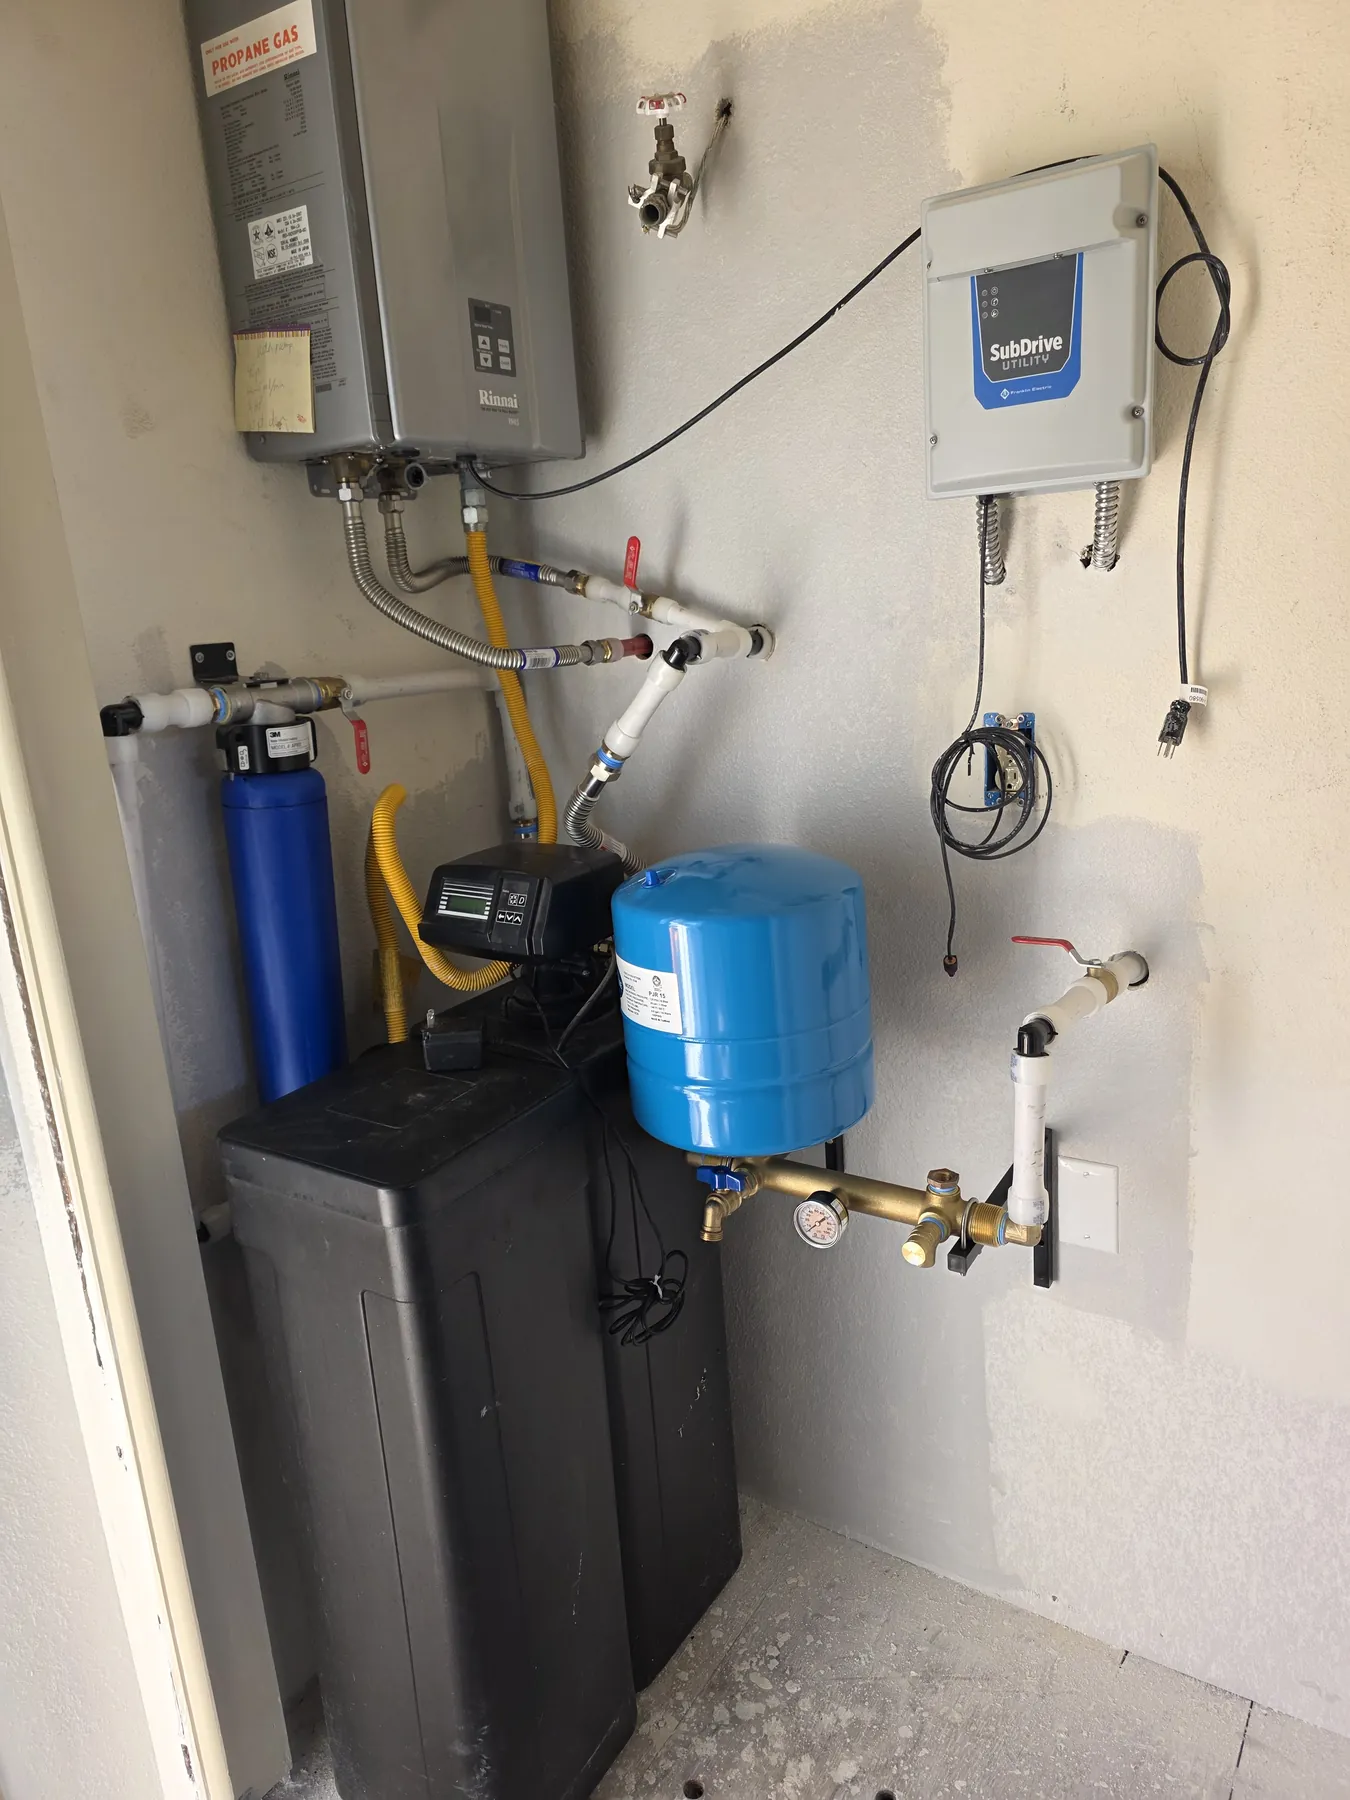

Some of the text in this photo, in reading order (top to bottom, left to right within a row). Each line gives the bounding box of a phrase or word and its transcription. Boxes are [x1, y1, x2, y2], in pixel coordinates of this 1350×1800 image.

[211, 37, 271, 76] PROPANE
[273, 24, 299, 49] GAS
[990, 335, 1063, 361] SubDrive
[1002, 353, 1050, 371] UTILITY
[478, 389, 519, 408] Rinnai
[648, 990, 659, 998] PJR
